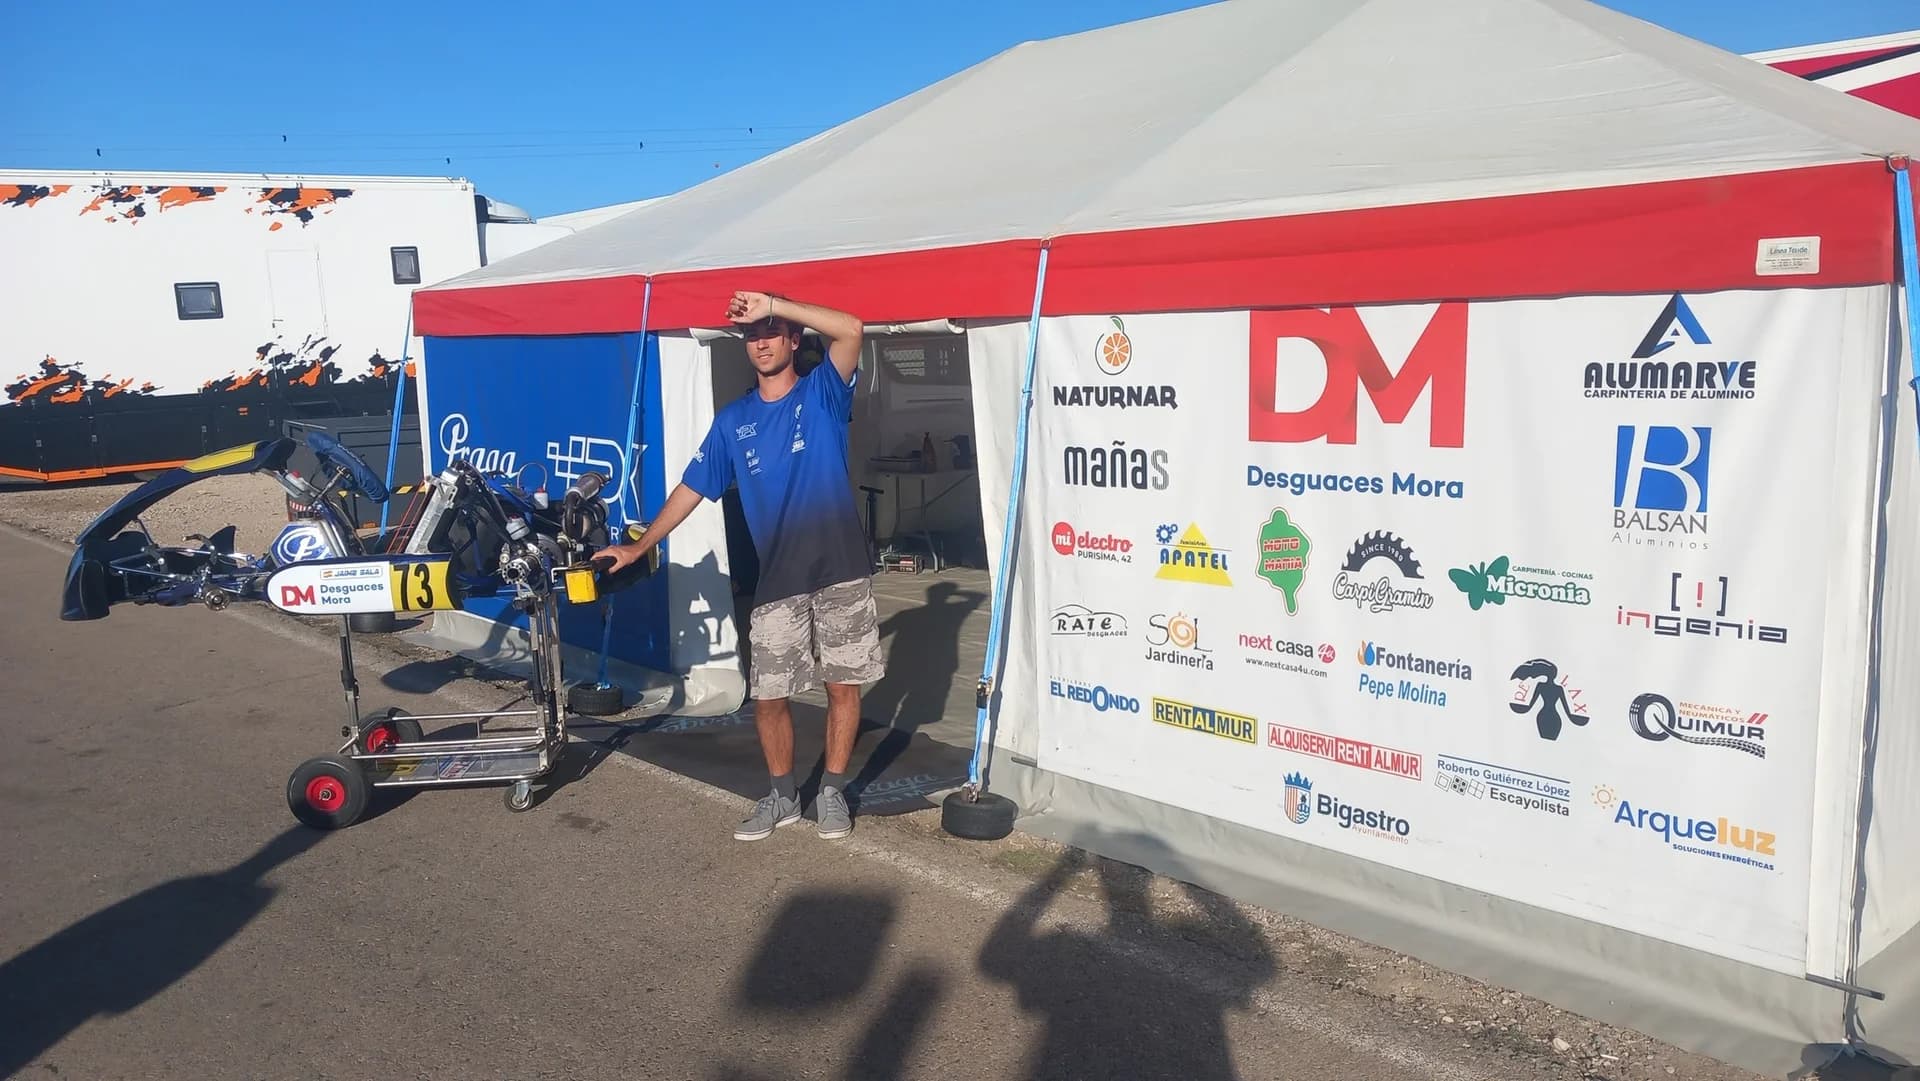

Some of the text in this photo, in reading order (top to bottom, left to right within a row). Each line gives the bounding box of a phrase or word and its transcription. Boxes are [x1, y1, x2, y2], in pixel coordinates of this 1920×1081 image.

[1249, 300, 1468, 448] DM
[1584, 361, 1756, 389] ALUMARVE
[1053, 385, 1178, 409] NATURNAR
[1584, 389, 1755, 399] CARPINTERIA DE ALUMINIO
[1064, 440, 1170, 490] mañas
[1247, 465, 1464, 498] Desguaces Mora
[1613, 509, 1708, 534] BALSAN
[1056, 531, 1133, 552] mi electro
[1263, 537, 1299, 551] MOTO
[1360, 543, 1404, 562] SINCE 1980
[1611, 532, 1709, 550] Aluminios
[1121, 554, 1132, 563] 42
[1160, 548, 1228, 571] APATEL
[320, 582, 384, 595] Desguaces
[393, 563, 434, 611] 73
[1486, 574, 1591, 605] Micronia
[1561, 571, 1593, 580] COCINAS
[281, 584, 316, 607] DM
[321, 596, 351, 605] Mora
[1333, 572, 1433, 613] CarpiGramin
[1057, 617, 1112, 631] RATE
[1618, 605, 1787, 643] ingenia
[1239, 633, 1273, 651] next
[1275, 640, 1314, 658] casa
[1245, 656, 1328, 678] www.nextcasa4u.com
[1376, 646, 1472, 681] Fontanería
[1050, 681, 1066, 698] EL
[1067, 685, 1140, 713] REDONDO
[1359, 673, 1447, 707] Pepe Molina
[1629, 692, 1765, 742] QUIMUR
[1270, 727, 1419, 777] ALQUISERVI RENT ALMUR
[1437, 759, 1570, 798] Roberto Gutiérrez López
[1317, 793, 1411, 837] Bigastro
[1489, 787, 1570, 817] Escayolista
[1614, 800, 1776, 857] Arqueluz
[1672, 843, 1775, 872] SOLUCIONES ENERGÉTICAS
